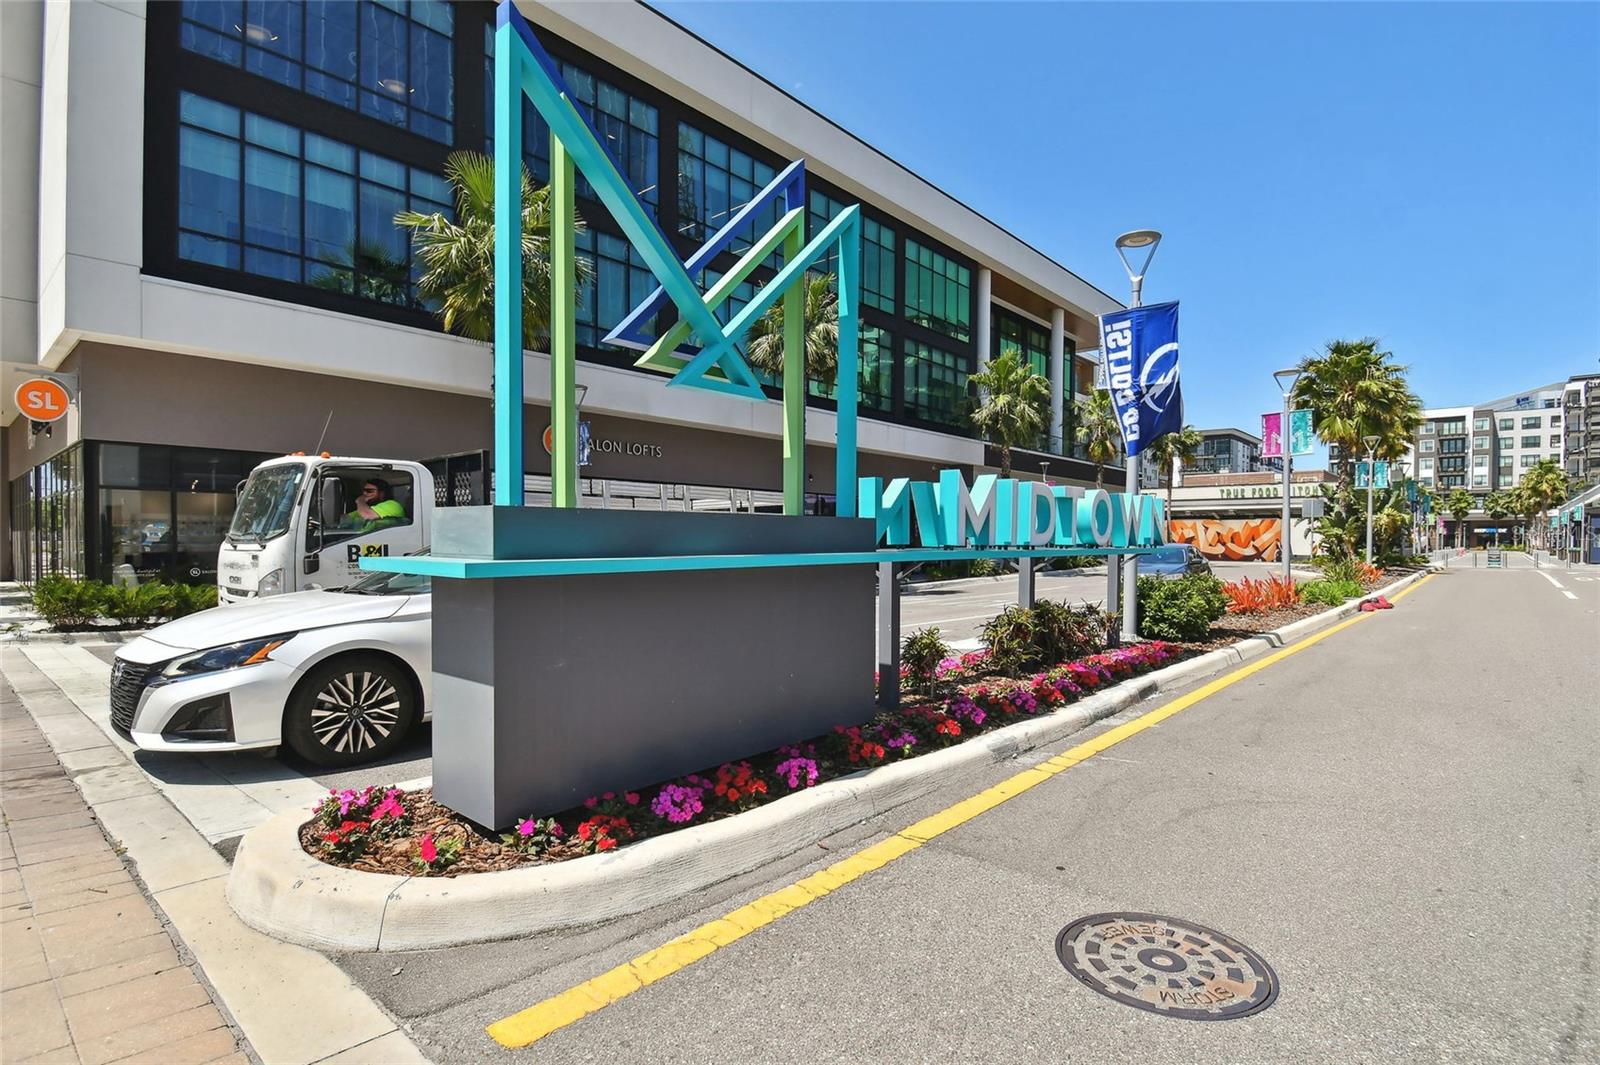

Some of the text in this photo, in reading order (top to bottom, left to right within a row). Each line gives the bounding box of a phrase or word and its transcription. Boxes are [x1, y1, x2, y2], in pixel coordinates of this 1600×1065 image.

[27, 390, 59, 410] SL
[588, 438, 663, 458] ALON LOFTS
[1219, 488, 1246, 499] TRUE
[1251, 486, 1279, 498] FOOD
[941, 469, 1168, 547] MIDTOWN
[1159, 985, 1235, 1005] STORM
